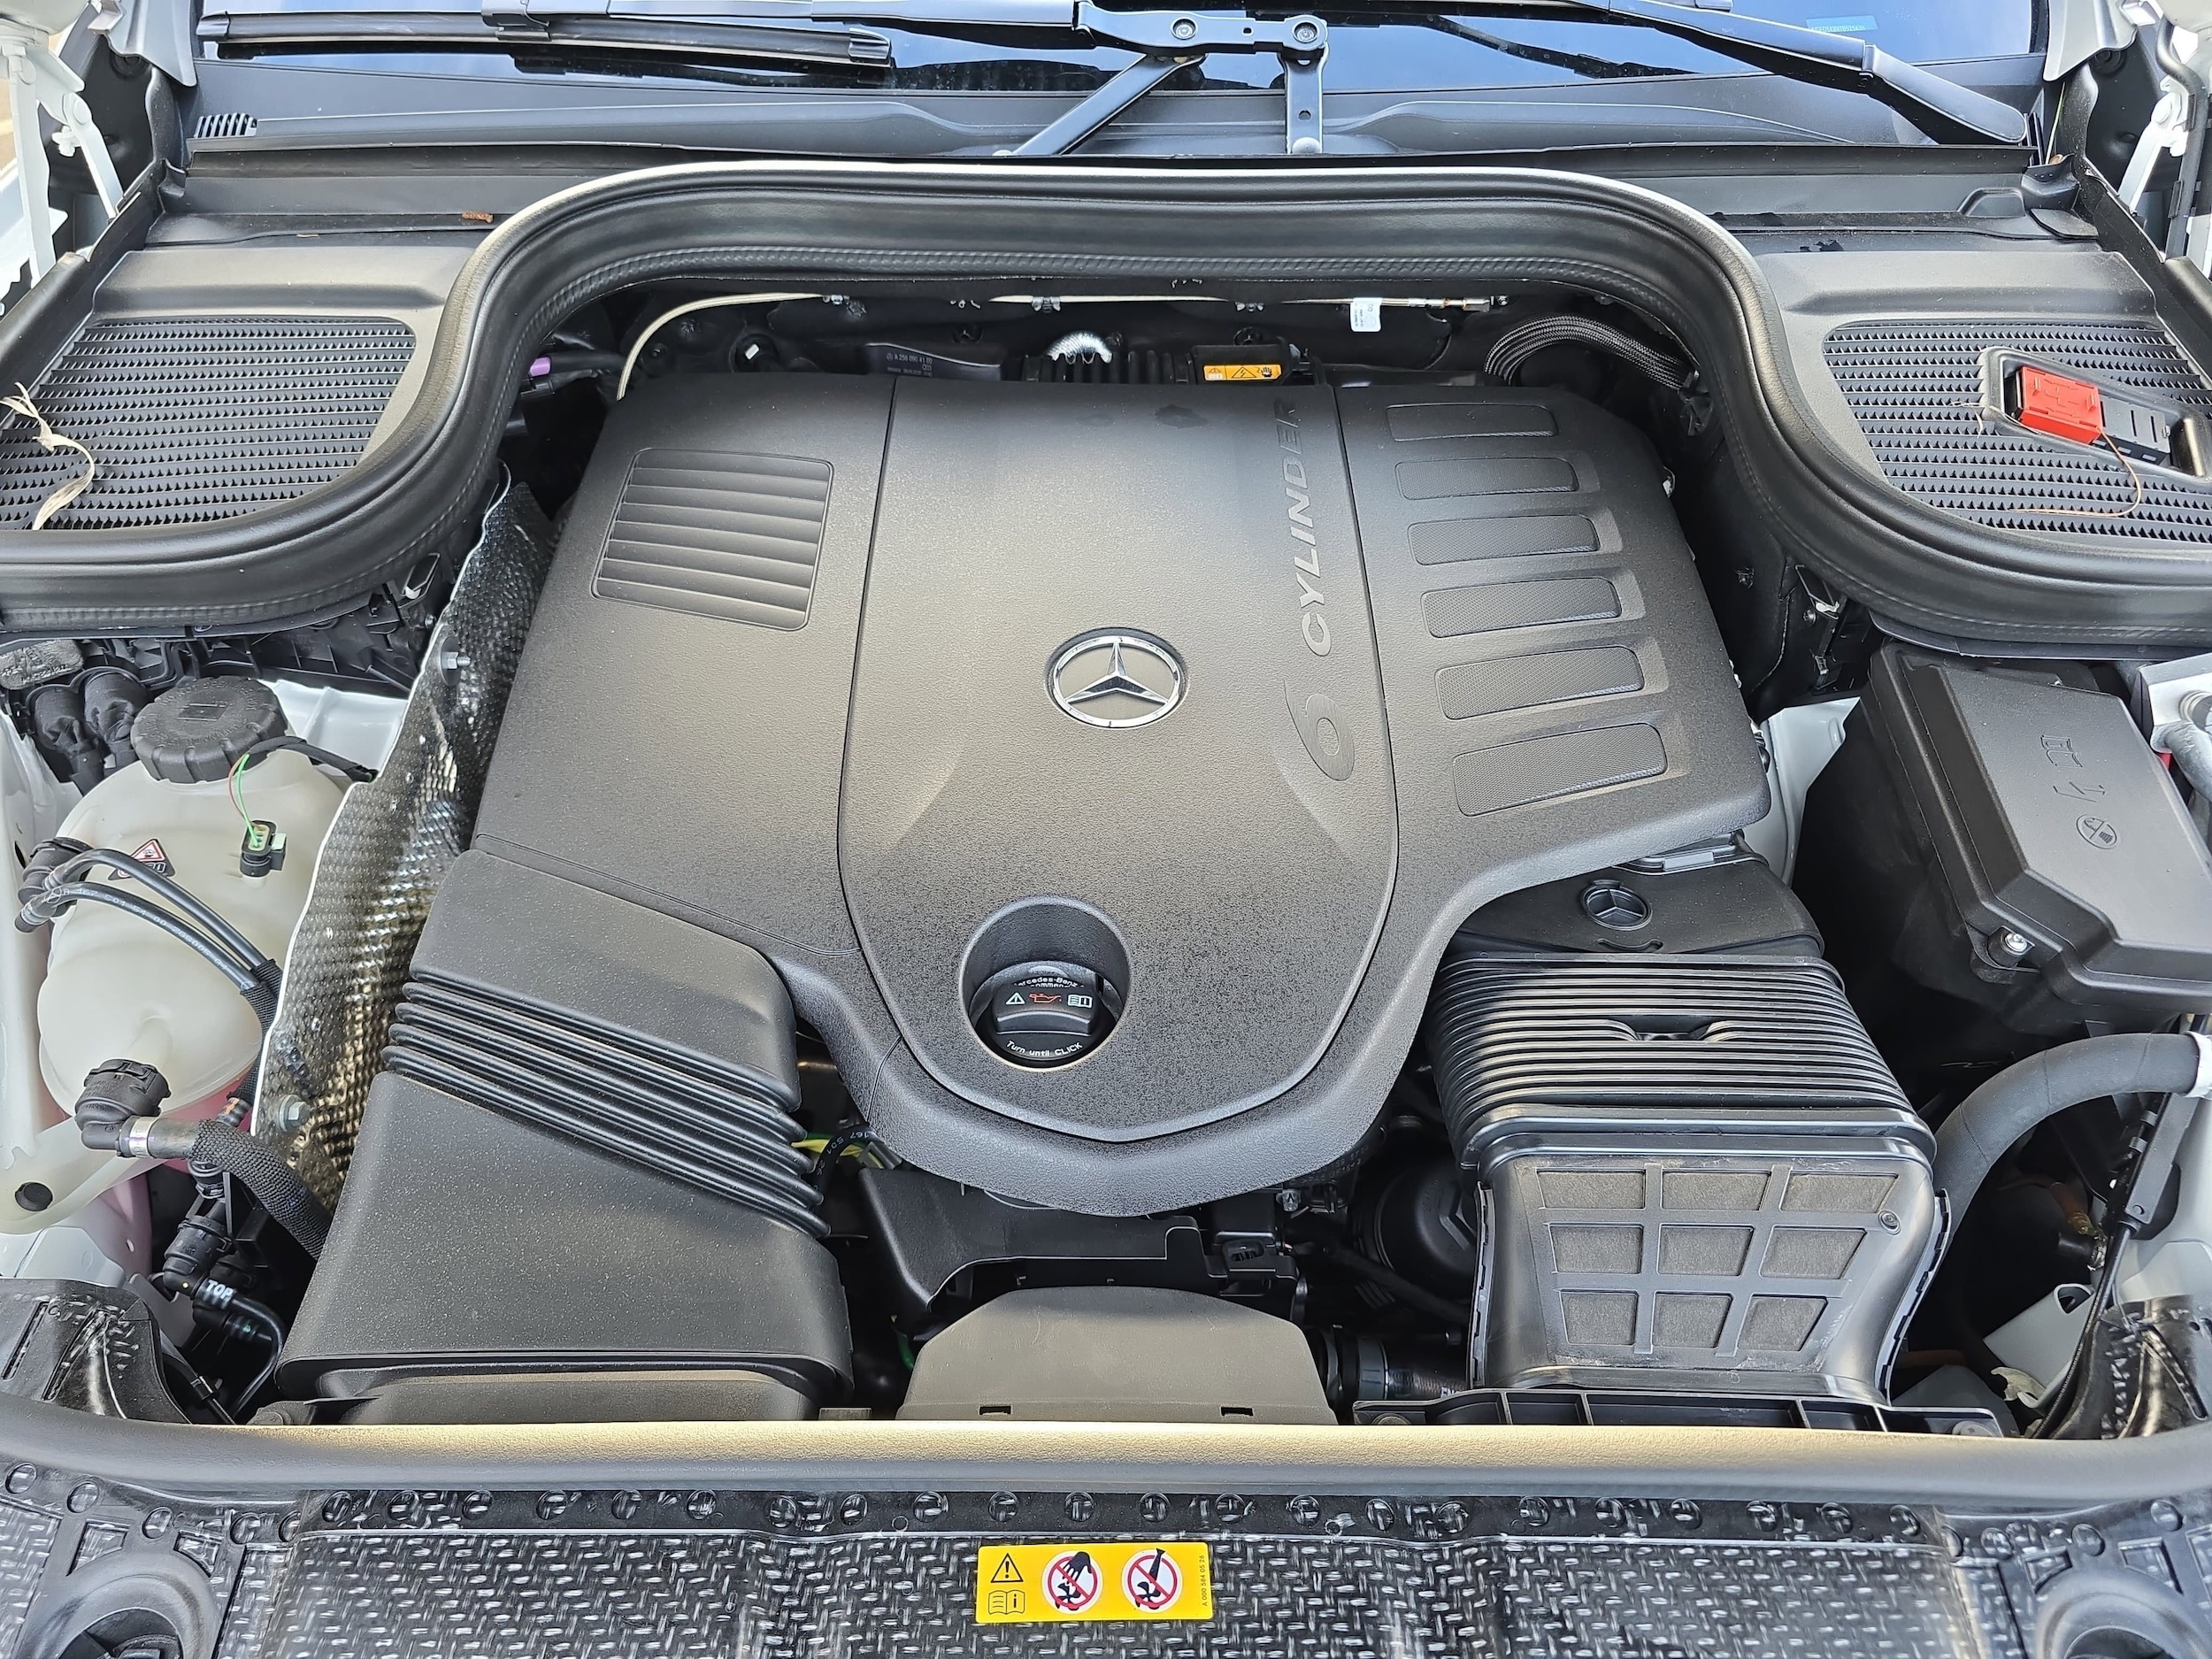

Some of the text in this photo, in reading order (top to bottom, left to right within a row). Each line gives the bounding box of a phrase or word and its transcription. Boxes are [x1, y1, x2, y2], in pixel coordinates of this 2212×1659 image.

[1274, 397, 1355, 780] 6 CYLINDER
[1014, 977, 1078, 987] ercedes-Benz
[1007, 1041, 1025, 1053] Turn
[1055, 1042, 1082, 1056] CLICK
[826, 1136, 844, 1155] 501
[206, 1279, 234, 1300] TOP
[1199, 1564, 1205, 1573] 05
